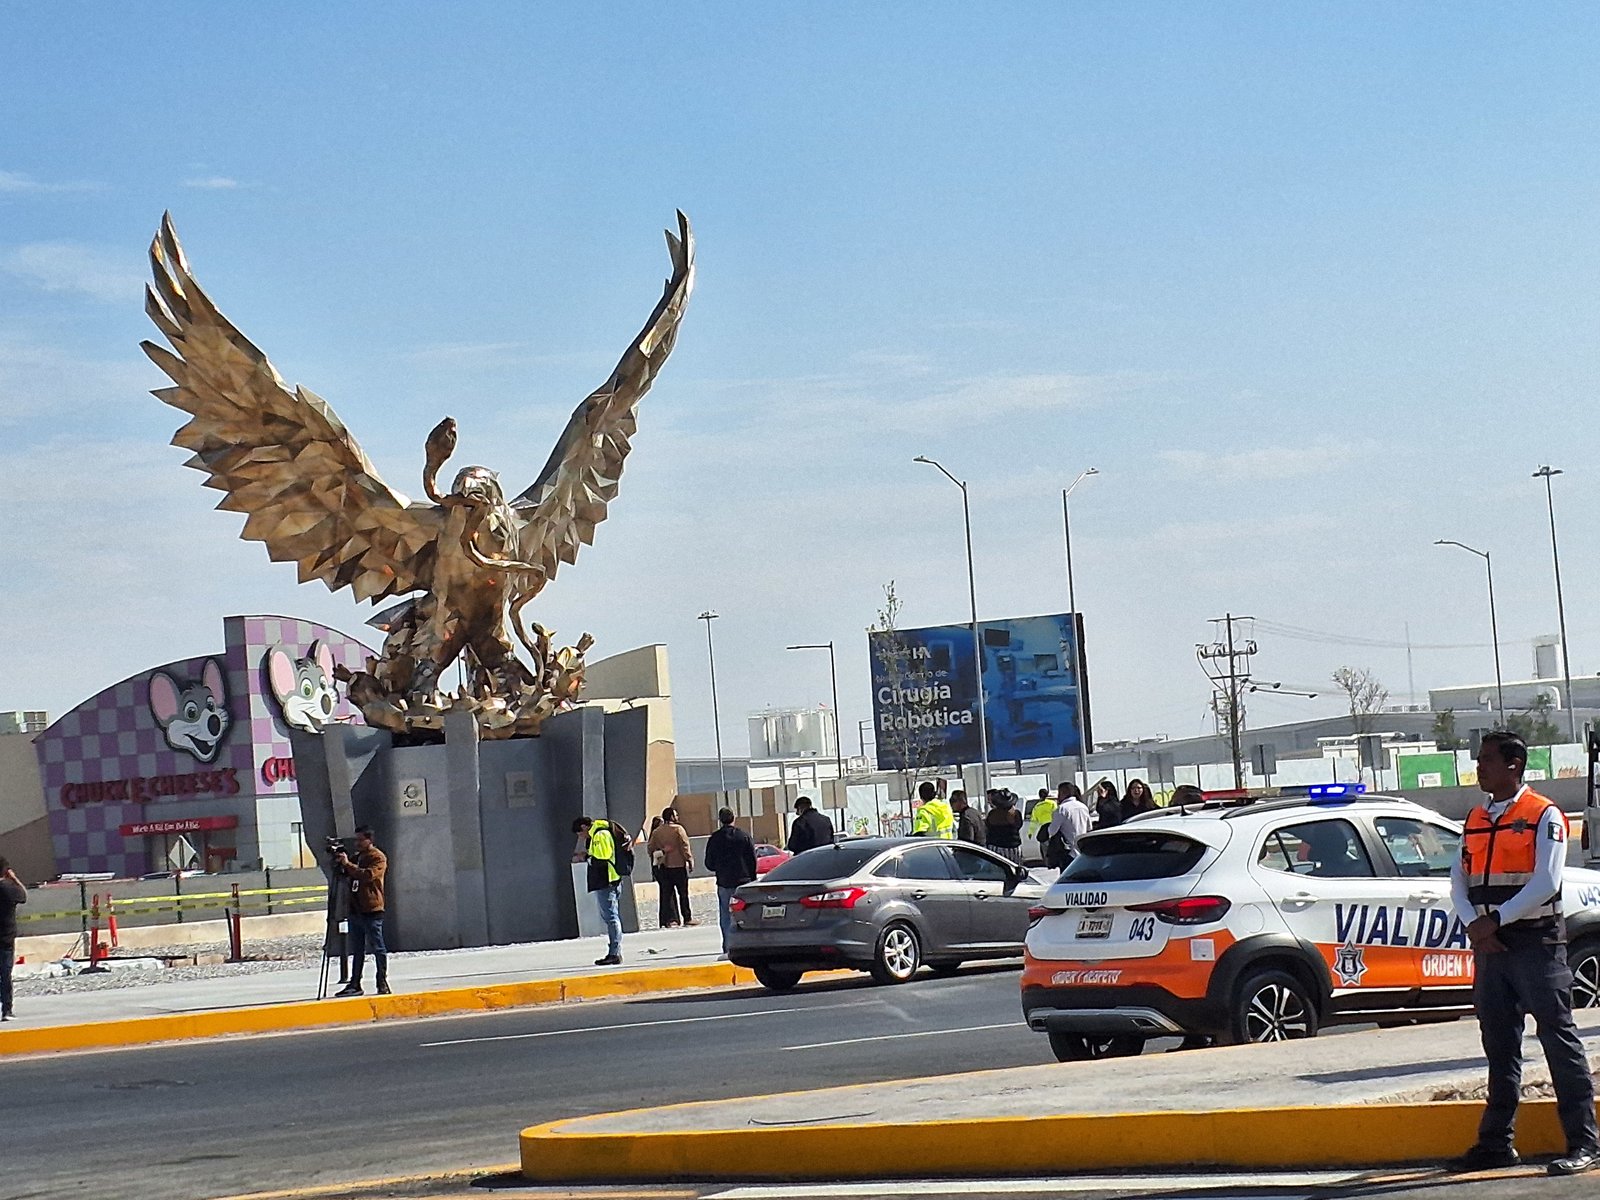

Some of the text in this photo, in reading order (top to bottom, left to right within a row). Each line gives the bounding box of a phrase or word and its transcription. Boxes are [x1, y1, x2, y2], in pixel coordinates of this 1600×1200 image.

[877, 681, 952, 705] Cirugía
[880, 706, 973, 731] Robótica
[1065, 891, 1108, 906] VIALIDAD
[1128, 916, 1155, 942] 043
[1334, 903, 1471, 950] VIALIDA
[1422, 954, 1474, 978] ORDEN Y
